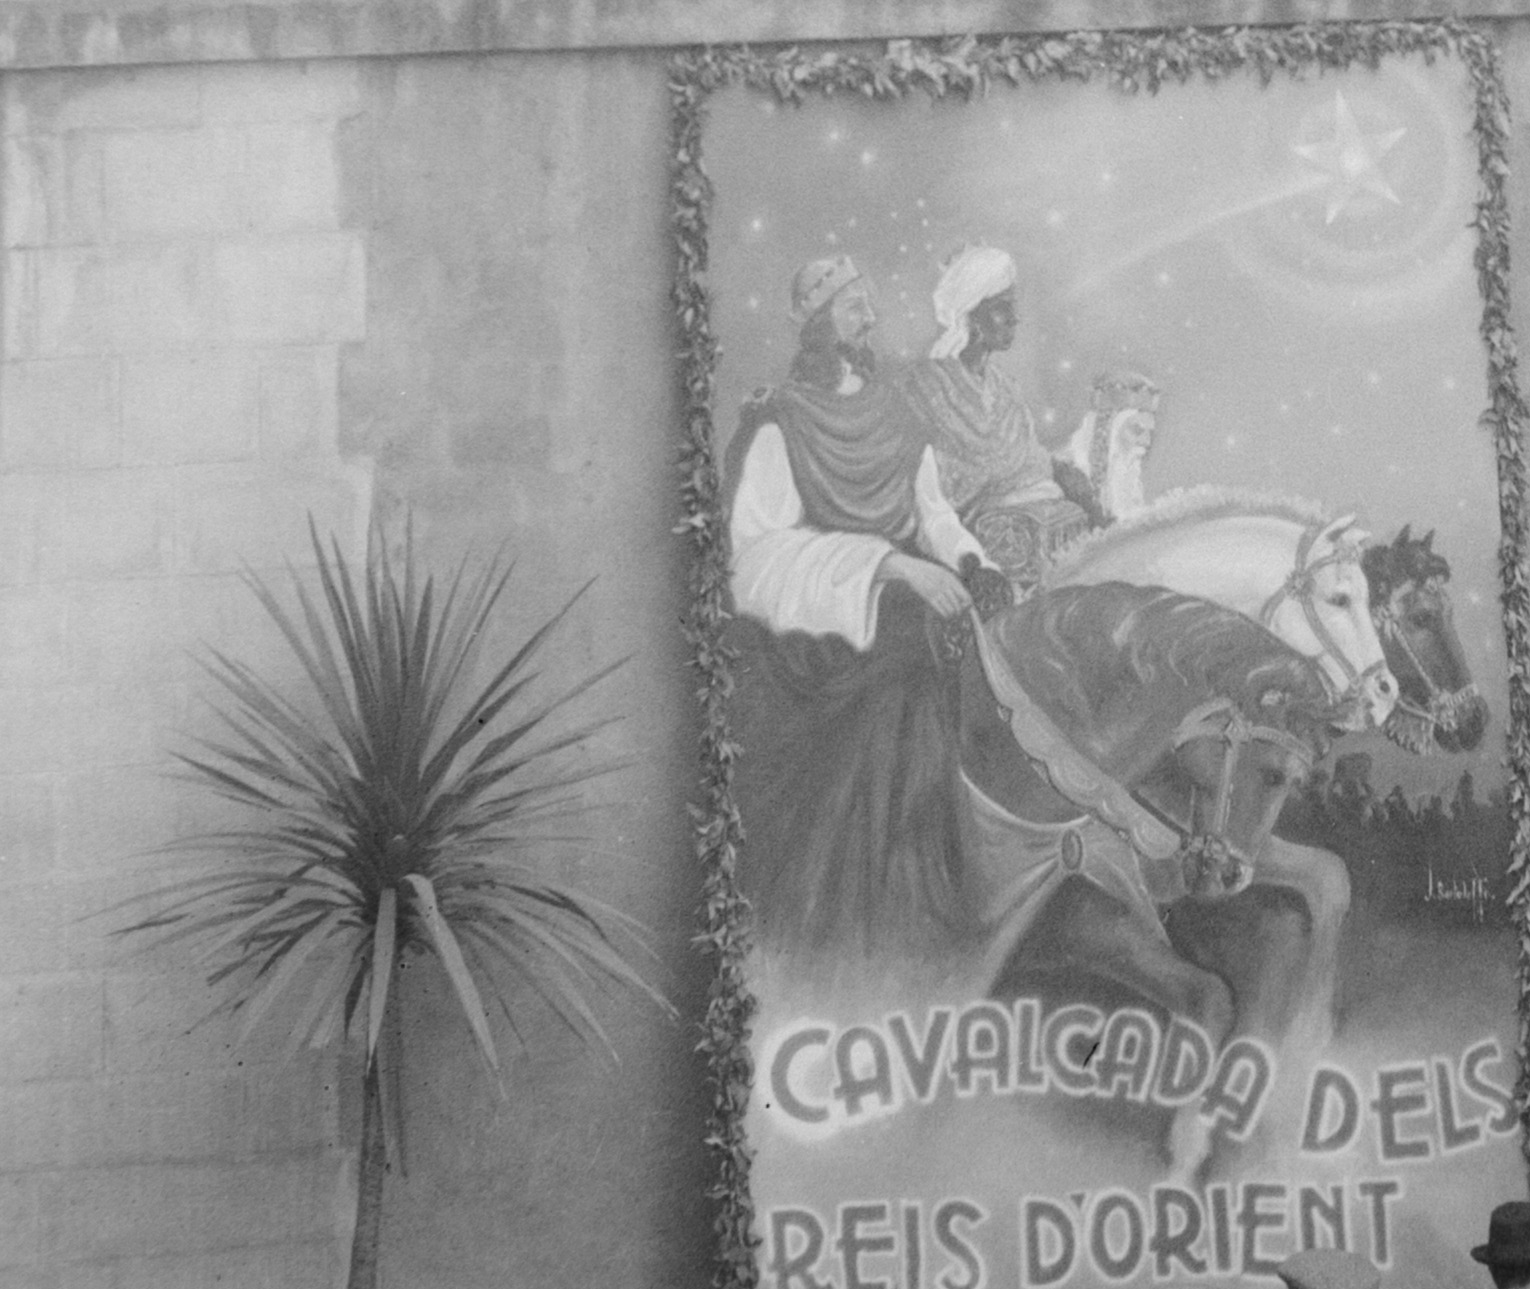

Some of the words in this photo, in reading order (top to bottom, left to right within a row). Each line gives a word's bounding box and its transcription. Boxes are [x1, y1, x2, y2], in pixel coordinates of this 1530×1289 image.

[770, 998, 1269, 1138] CAVALCADA
[1299, 1039, 1519, 1161] DELS
[1022, 1180, 1400, 1289] D'ORIENT
